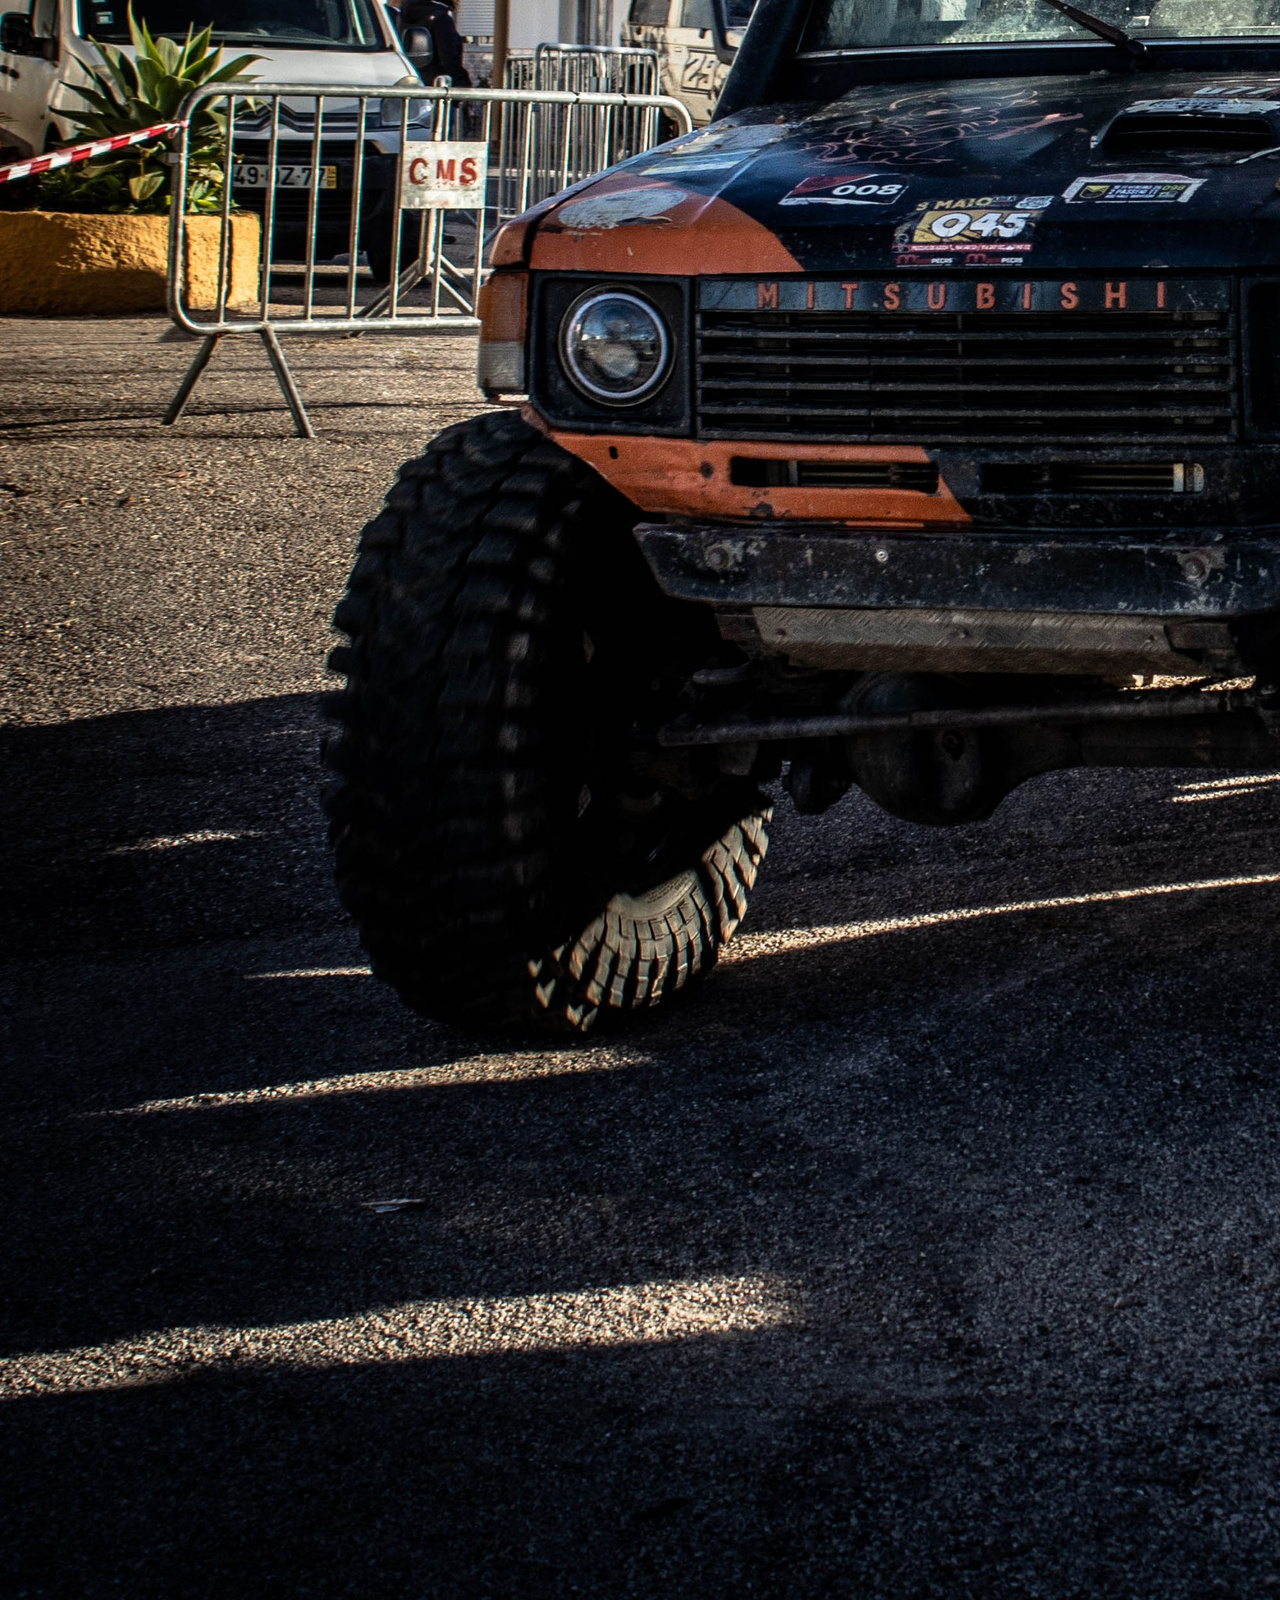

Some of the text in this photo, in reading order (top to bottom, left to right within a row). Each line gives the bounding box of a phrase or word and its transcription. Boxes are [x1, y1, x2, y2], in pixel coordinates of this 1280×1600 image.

[409, 157, 477, 186] CMS
[832, 184, 903, 196] 008
[934, 197, 993, 210] MAIO
[931, 212, 1033, 238] 045
[756, 281, 1167, 309] MITSUBISHI
